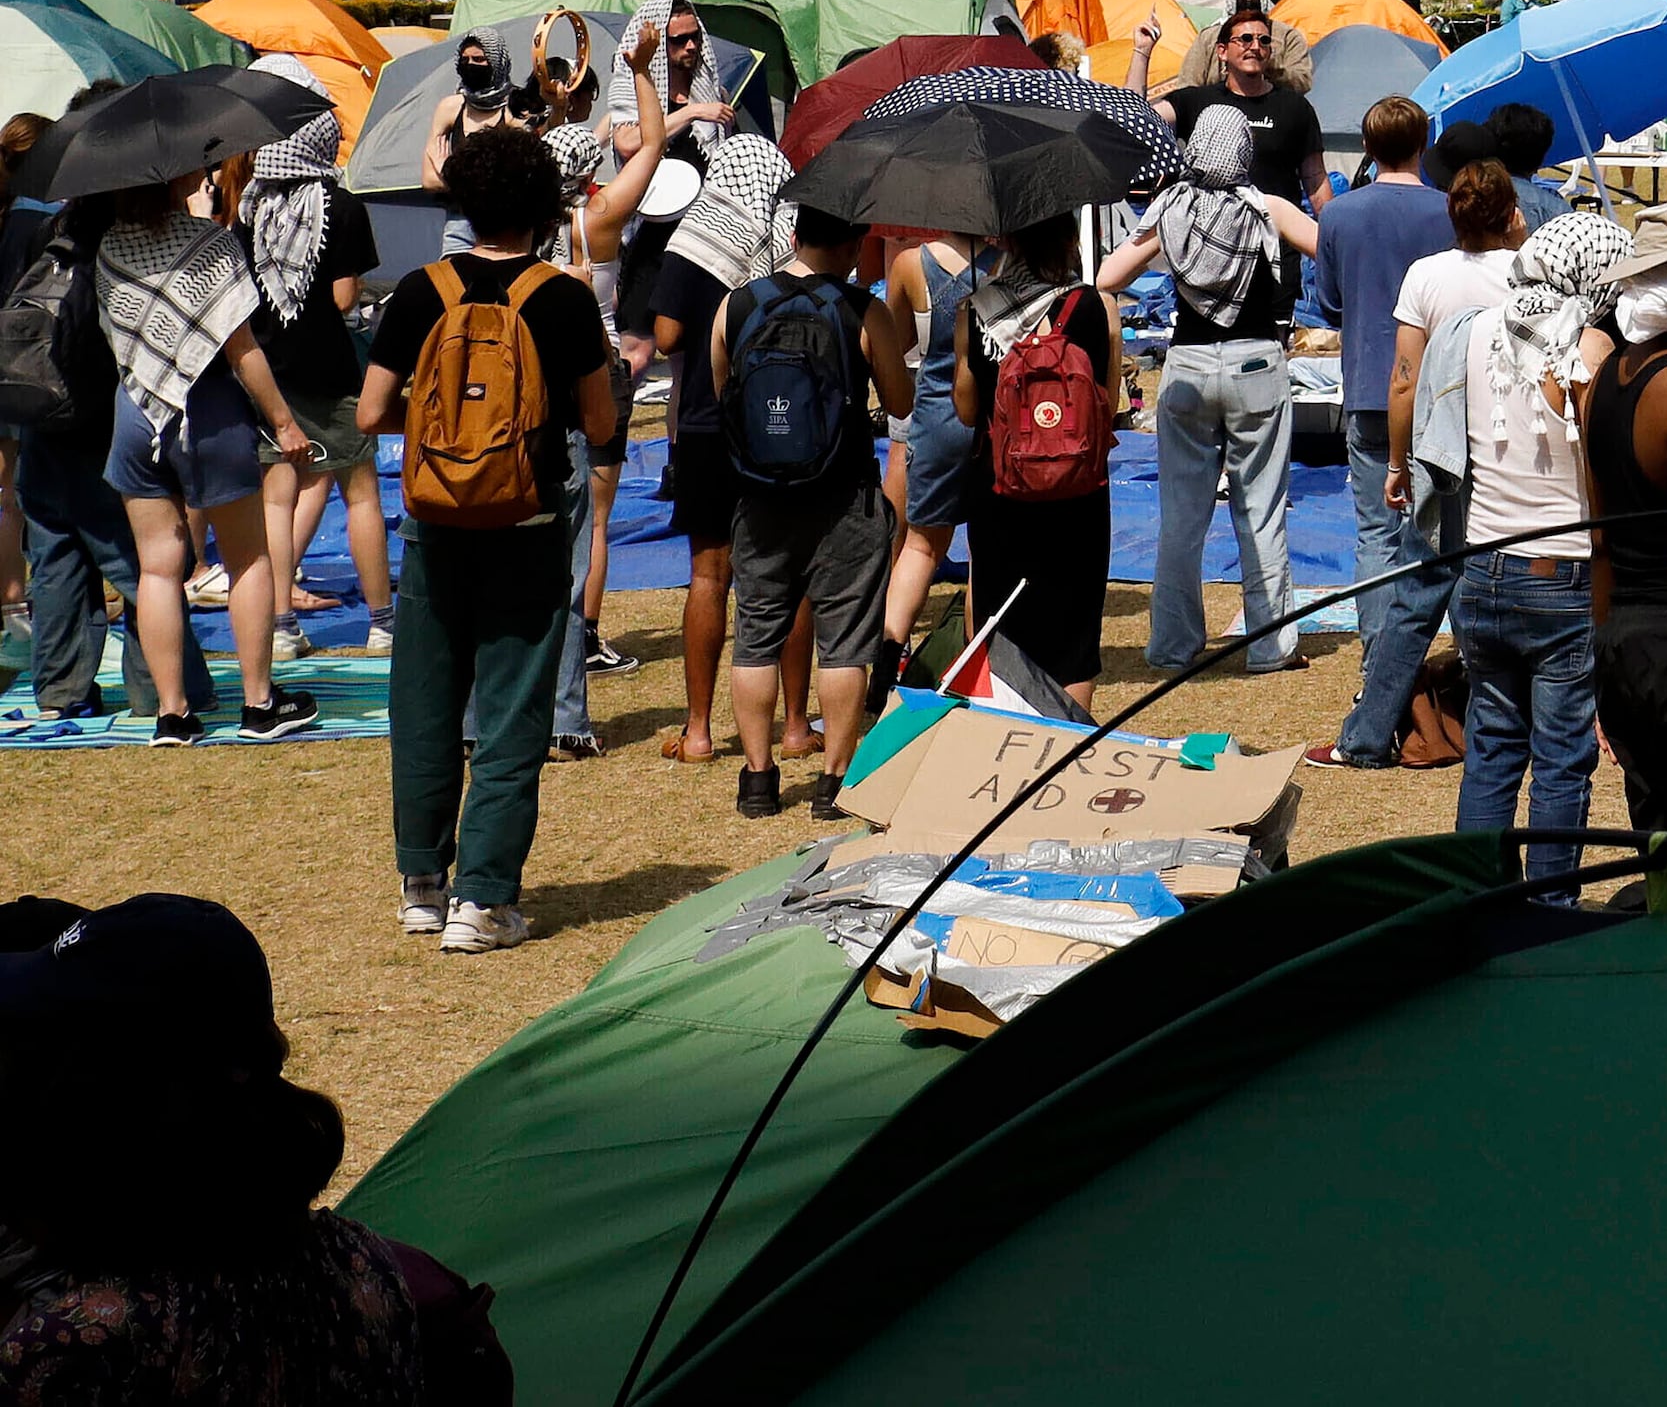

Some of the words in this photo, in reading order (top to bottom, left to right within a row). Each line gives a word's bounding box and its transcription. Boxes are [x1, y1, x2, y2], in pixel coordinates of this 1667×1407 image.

[769, 415, 788, 424] SIPA
[995, 729, 1181, 781] FIRST
[956, 930, 1017, 966] NO
